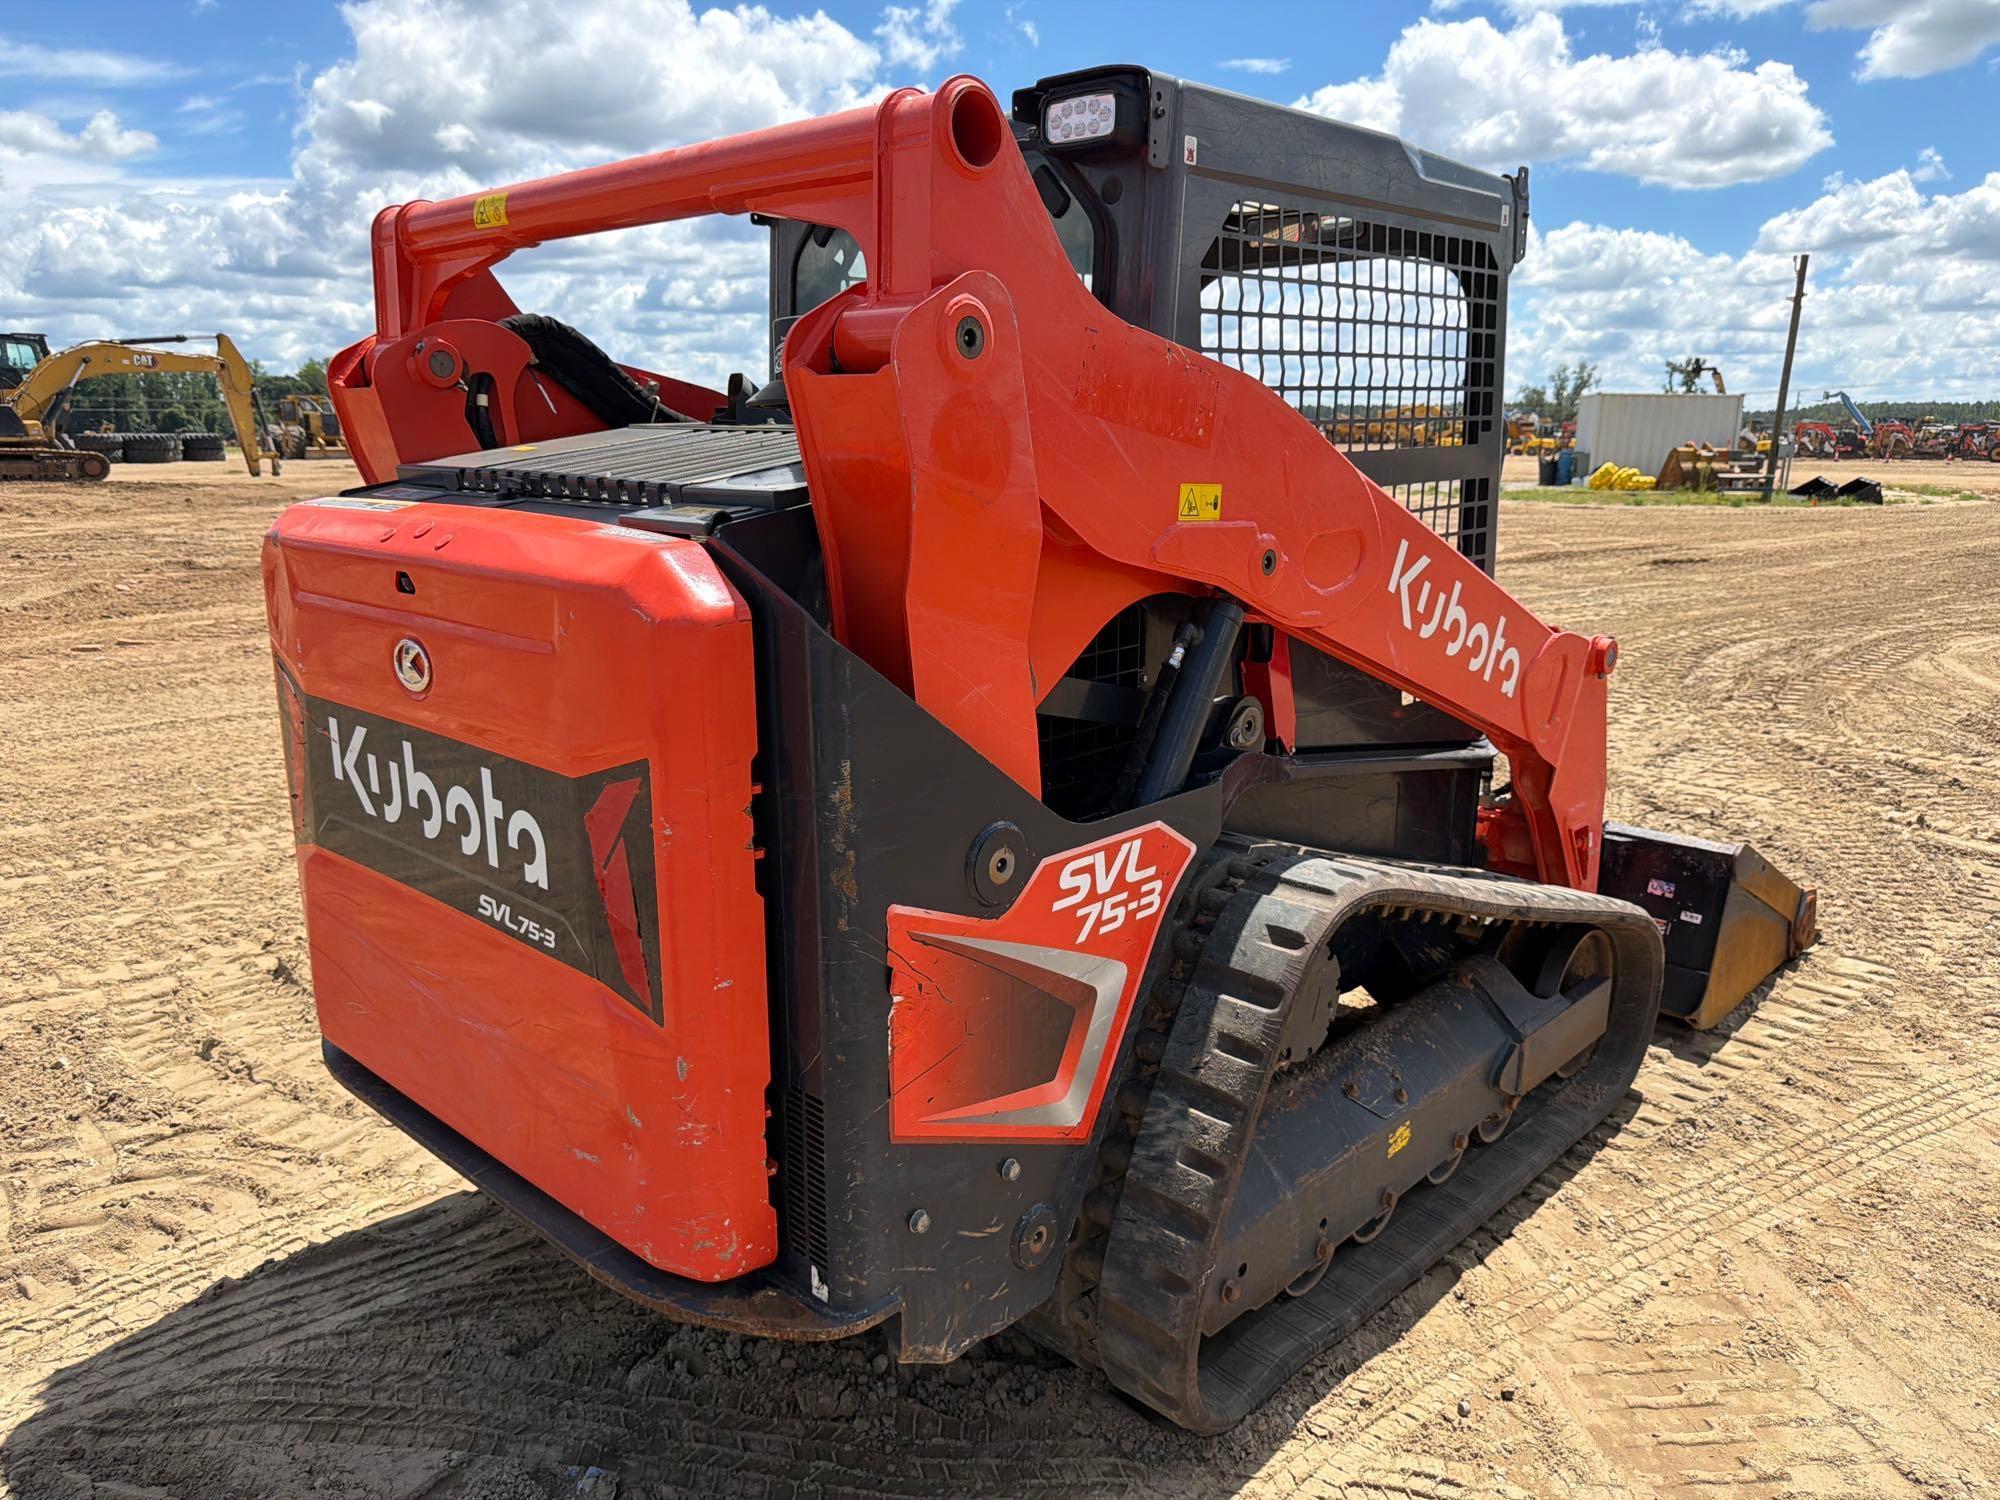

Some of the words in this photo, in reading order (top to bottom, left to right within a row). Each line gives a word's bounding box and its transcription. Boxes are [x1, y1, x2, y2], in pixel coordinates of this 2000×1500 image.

[133, 354, 153, 367] CAT
[1387, 537, 1521, 699] Kubota
[328, 716, 549, 891] Kubota
[1051, 837, 1157, 913] SVL
[1075, 879, 1163, 945] 75-3
